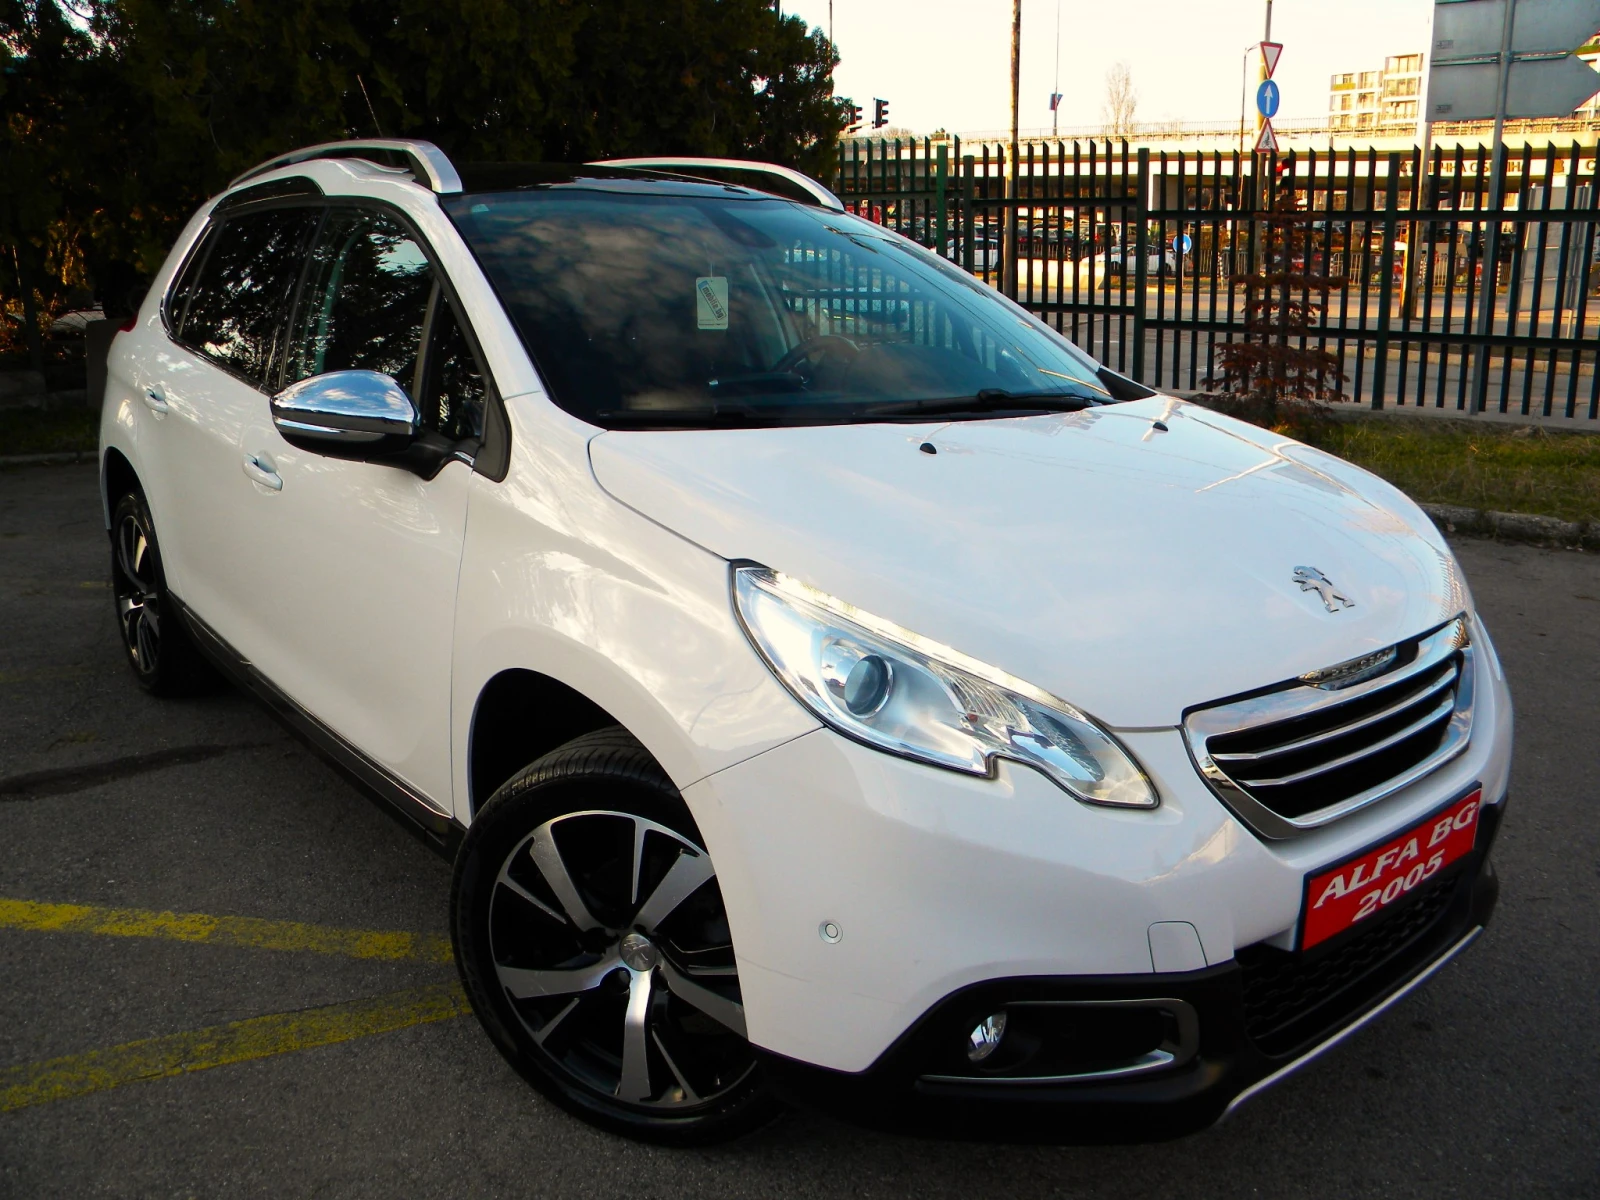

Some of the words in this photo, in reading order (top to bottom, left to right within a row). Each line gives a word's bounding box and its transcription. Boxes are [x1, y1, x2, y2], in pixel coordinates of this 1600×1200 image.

[1312, 838, 1419, 909] ALFA
[1427, 801, 1478, 849] BG
[1351, 849, 1446, 922] 2005
